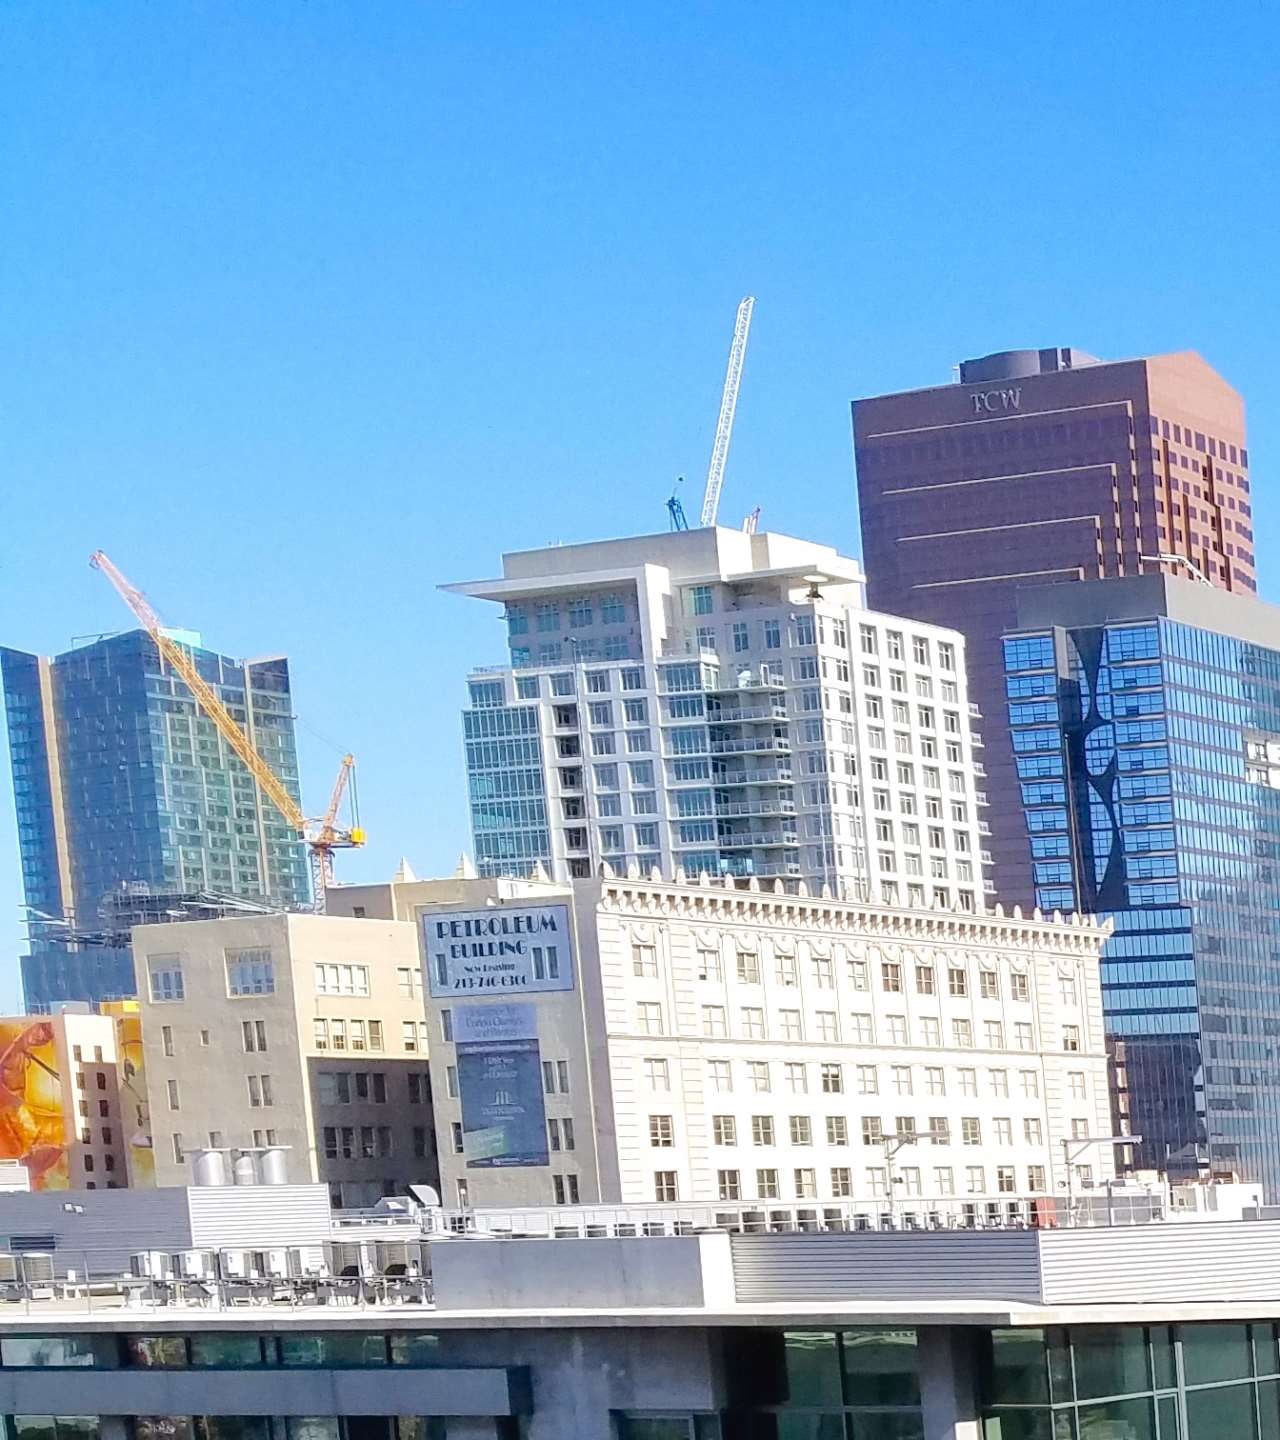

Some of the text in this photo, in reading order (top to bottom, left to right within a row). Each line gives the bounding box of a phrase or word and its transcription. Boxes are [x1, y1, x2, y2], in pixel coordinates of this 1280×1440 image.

[970, 387, 1022, 413] TCW
[436, 914, 557, 938] PETROLEUM
[451, 940, 527, 959] BUILDING
